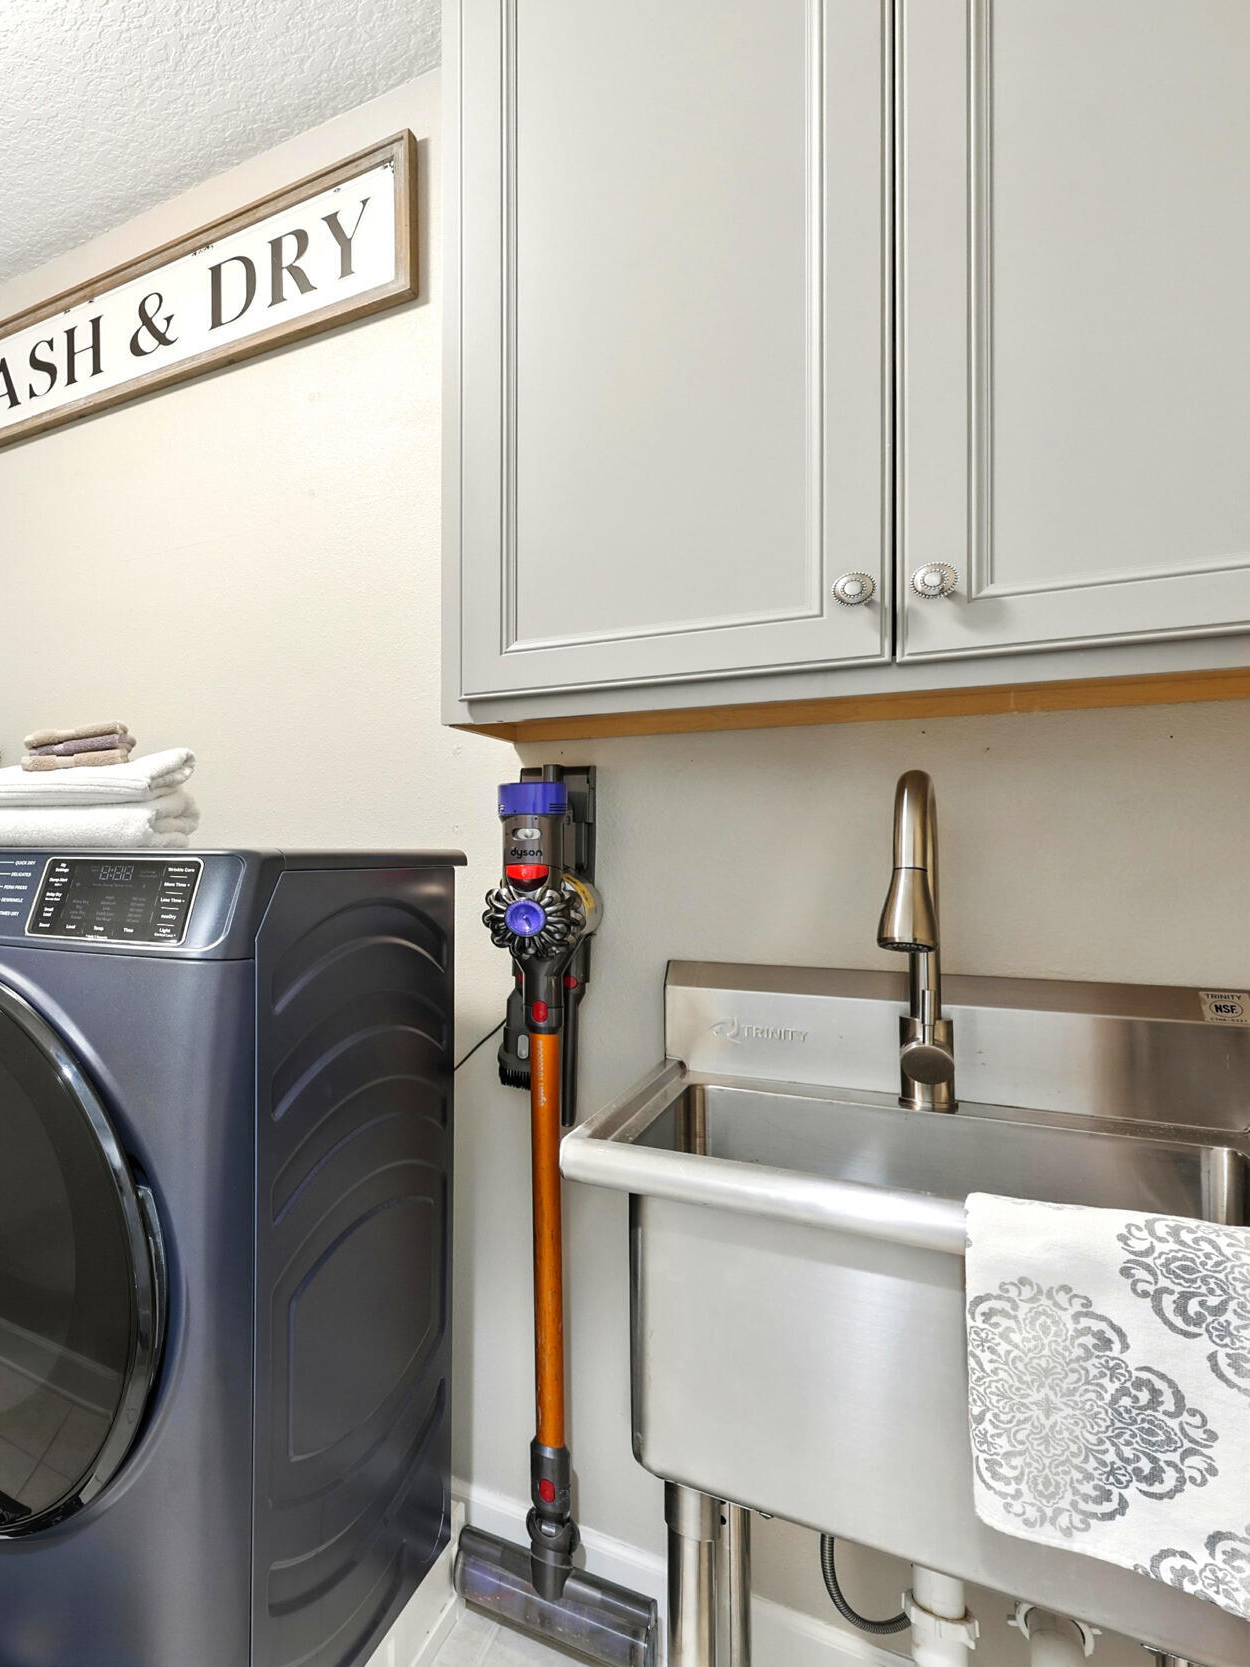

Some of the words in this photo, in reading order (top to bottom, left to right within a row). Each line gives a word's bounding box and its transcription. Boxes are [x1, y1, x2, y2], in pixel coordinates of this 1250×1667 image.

[129, 292, 179, 357] &
[208, 197, 371, 331] DRY
[510, 847, 543, 859] dyson
[1214, 1004, 1237, 1014] NSF
[741, 1024, 808, 1042] TRINITY
